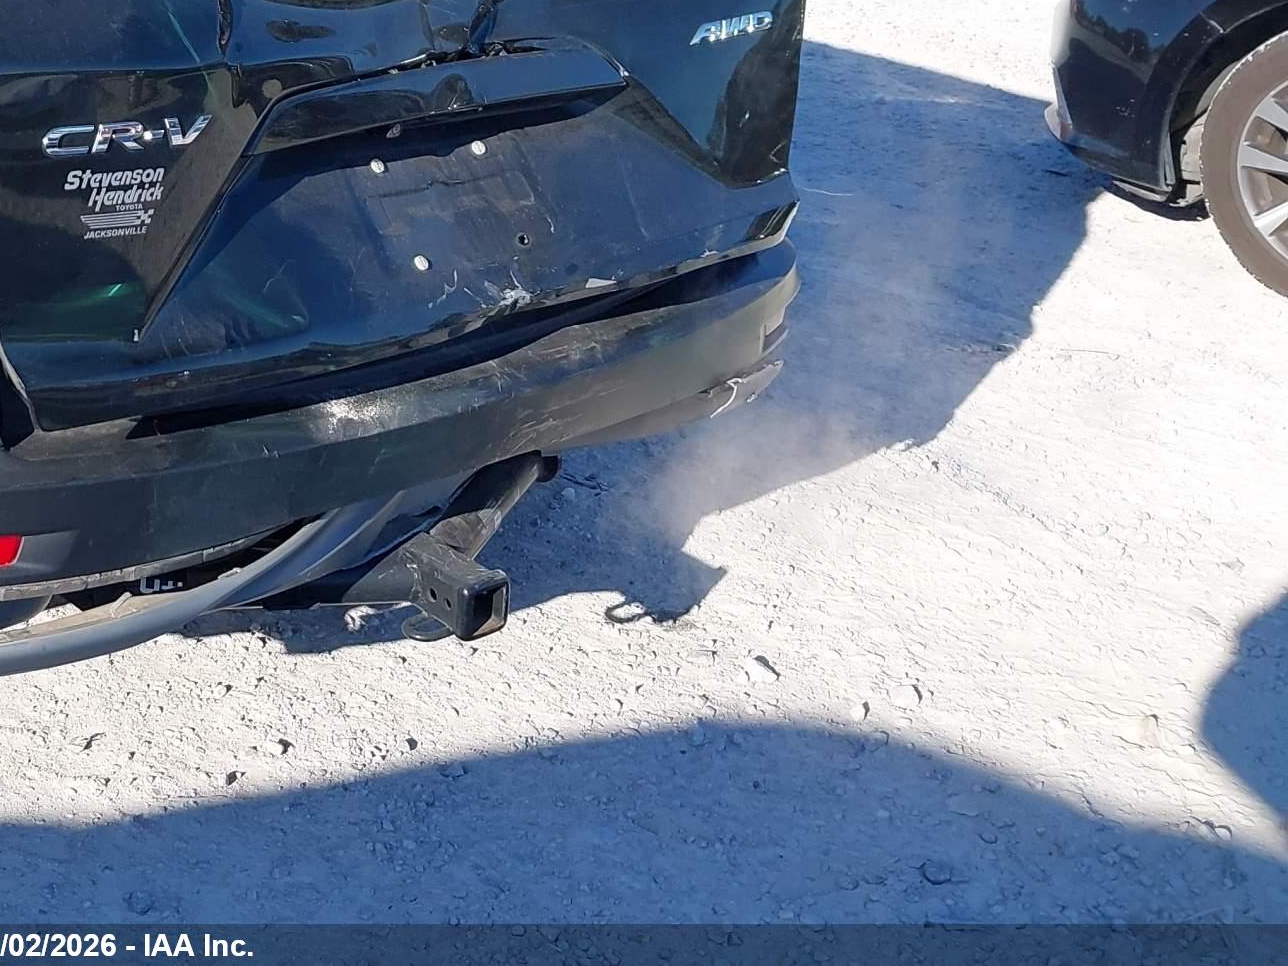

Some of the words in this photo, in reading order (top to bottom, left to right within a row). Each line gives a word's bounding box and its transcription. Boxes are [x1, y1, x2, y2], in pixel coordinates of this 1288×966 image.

[689, 10, 774, 46] AWD
[41, 113, 213, 159] CR-V
[63, 167, 165, 191] Stevenson
[87, 183, 165, 212] Hendrick
[115, 203, 144, 211] TOYOTA
[83, 226, 148, 240] JACKSONVILLE
